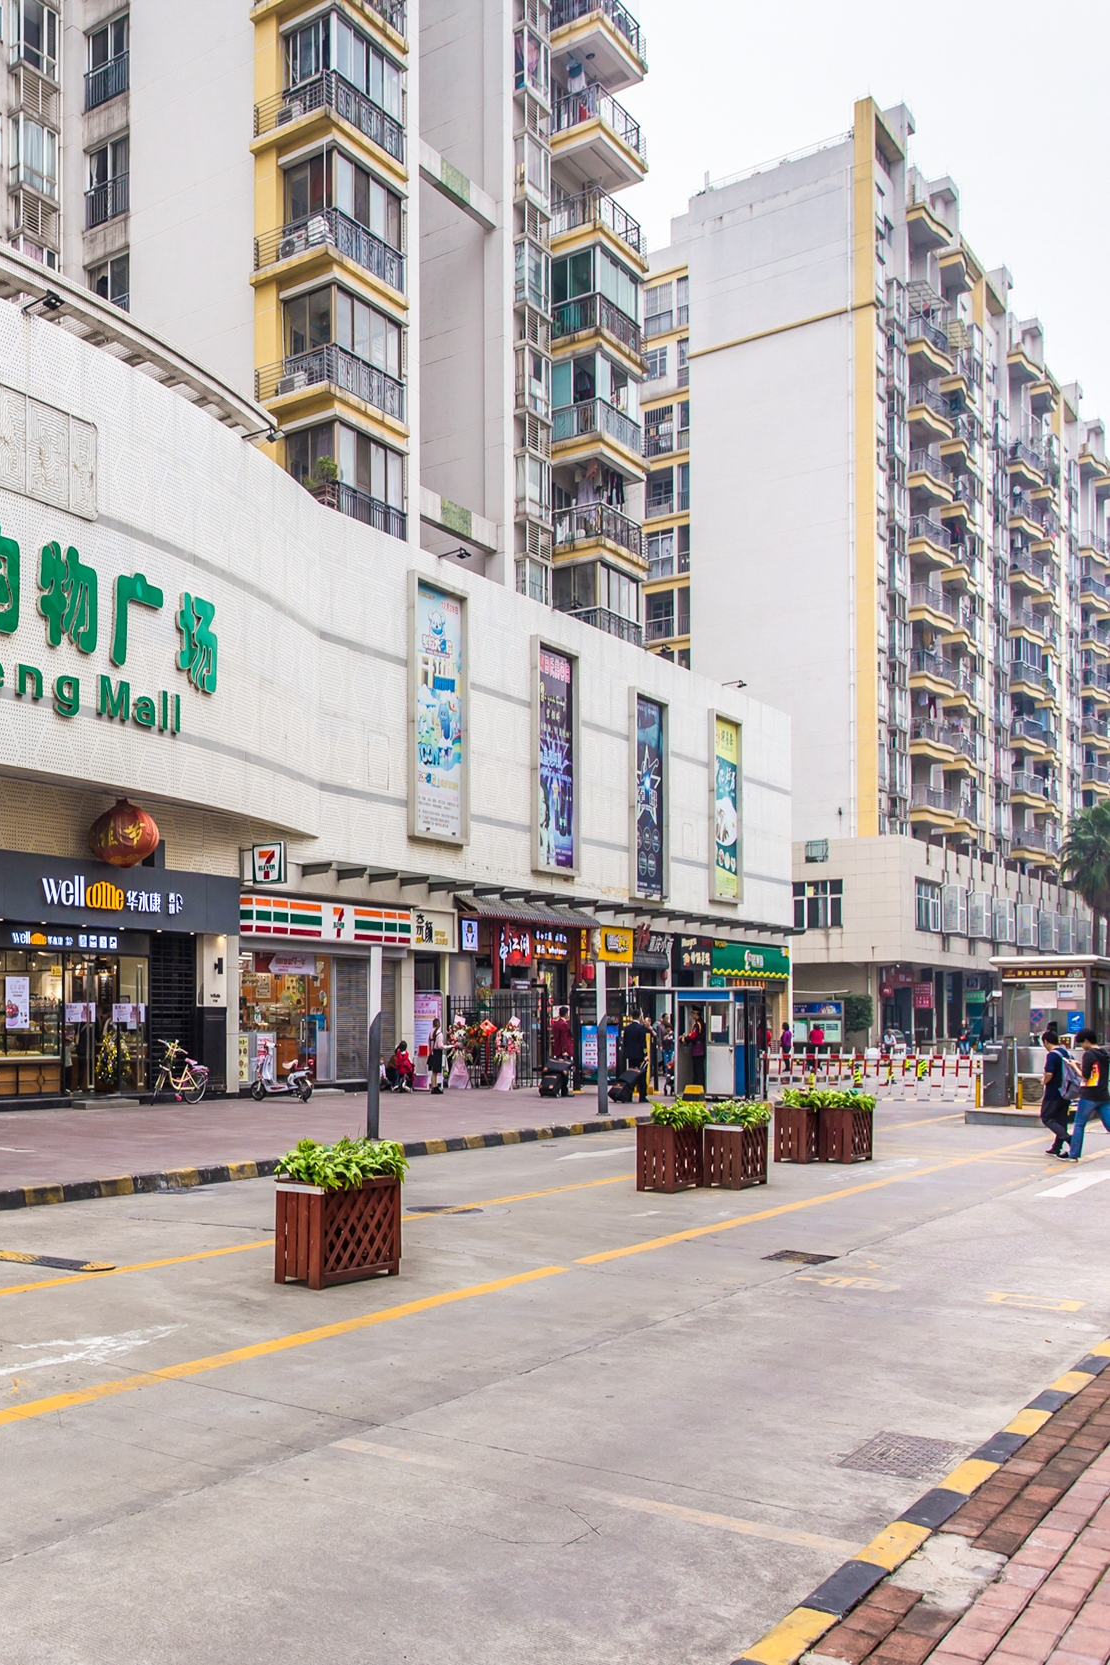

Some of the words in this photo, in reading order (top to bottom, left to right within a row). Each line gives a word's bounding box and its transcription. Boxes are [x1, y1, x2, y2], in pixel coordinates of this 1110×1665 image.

[96, 674, 182, 733] Mall
[126, 890, 162, 913] 华永康
